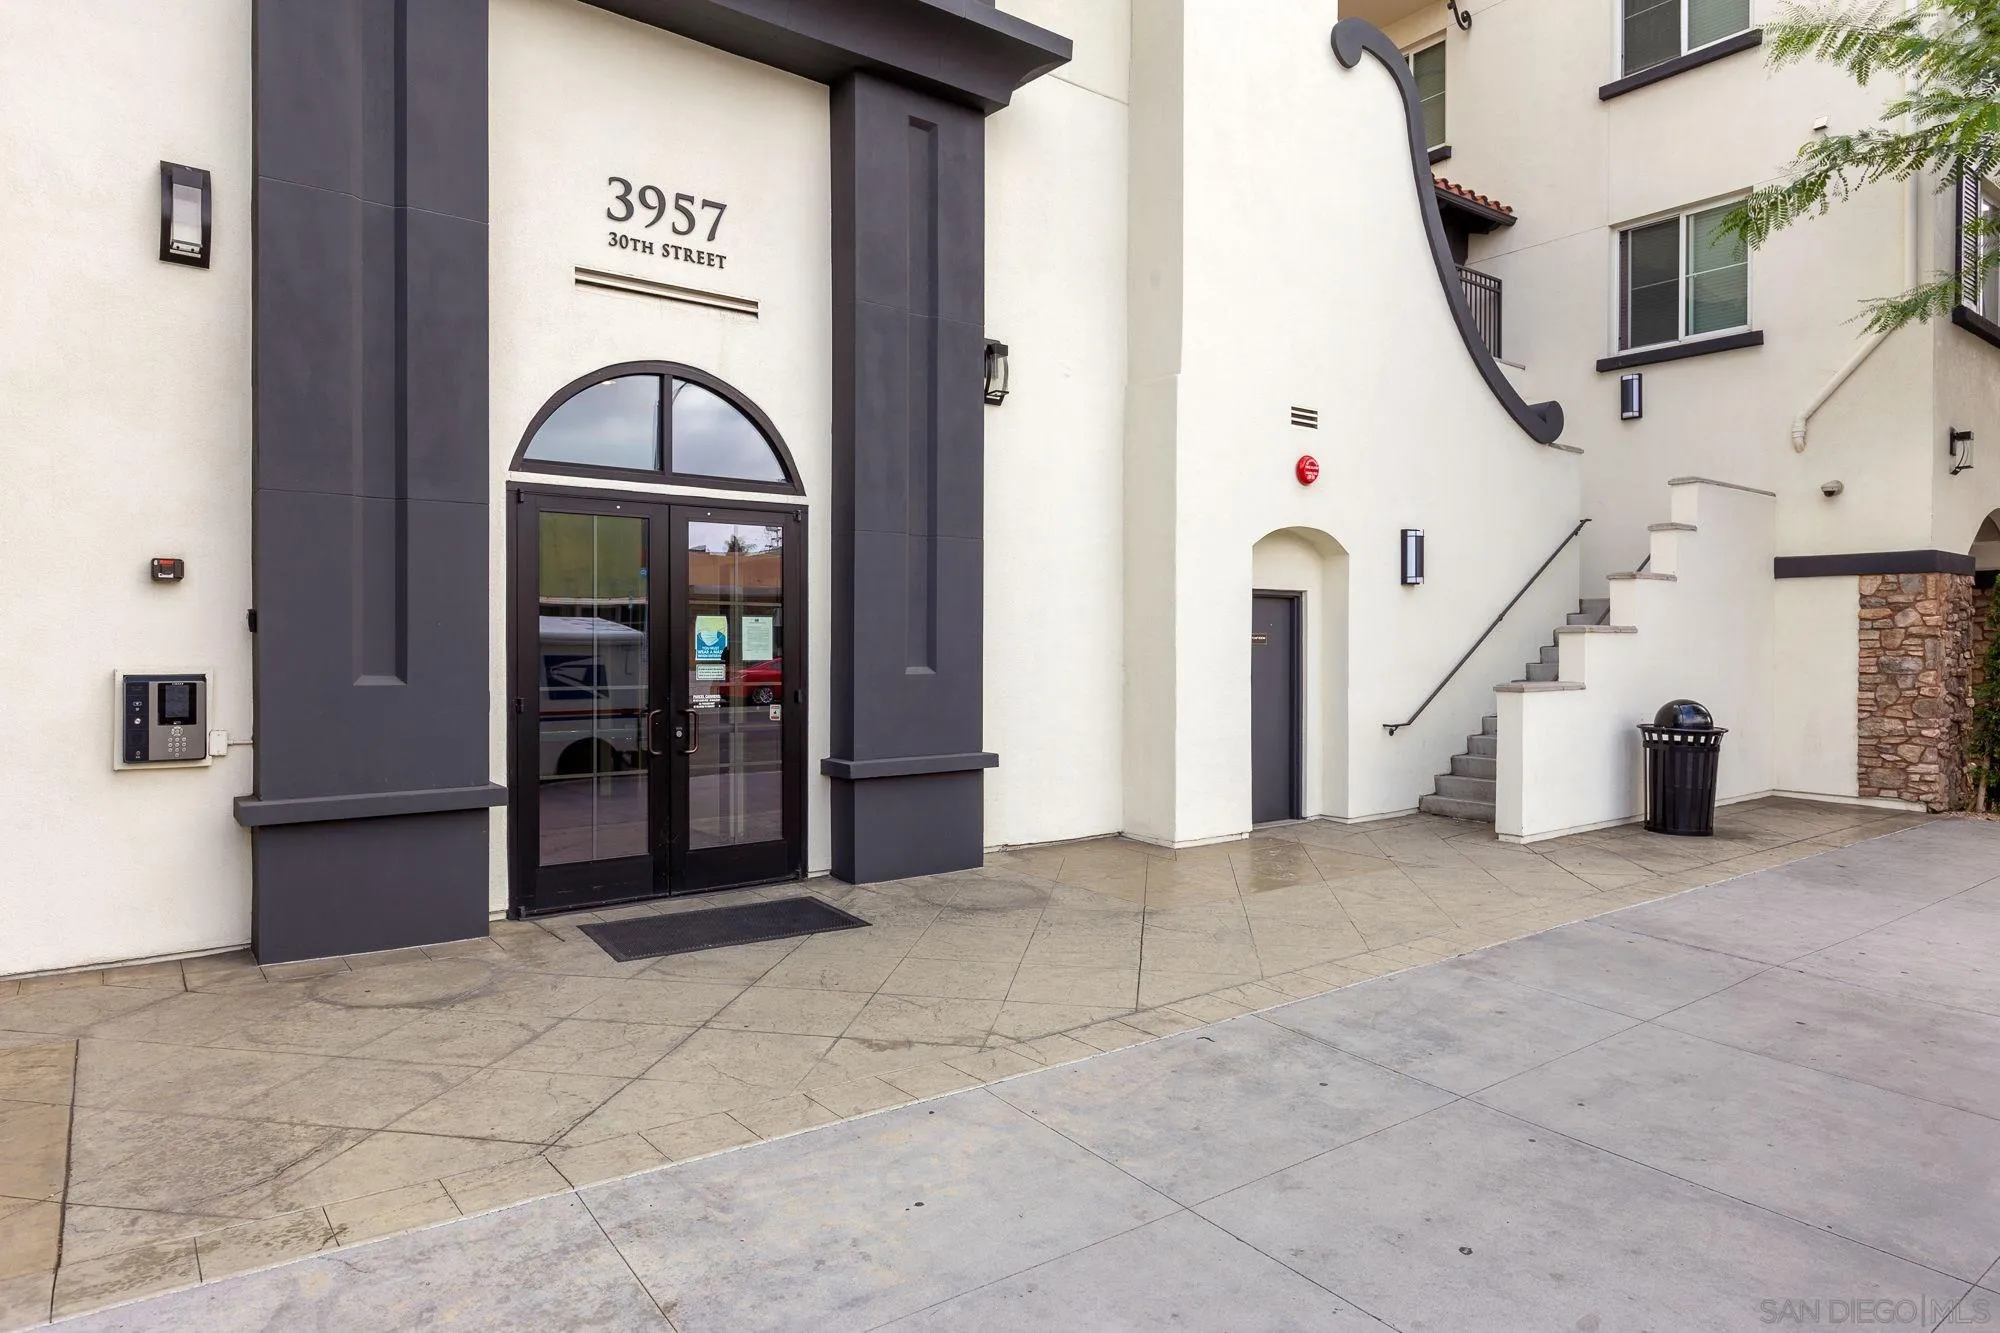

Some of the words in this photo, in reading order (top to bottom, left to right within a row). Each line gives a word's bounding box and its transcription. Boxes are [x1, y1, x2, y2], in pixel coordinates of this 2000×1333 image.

[607, 176, 727, 241] 3957
[608, 231, 654, 255] 30TH
[661, 243, 727, 269] STREET
